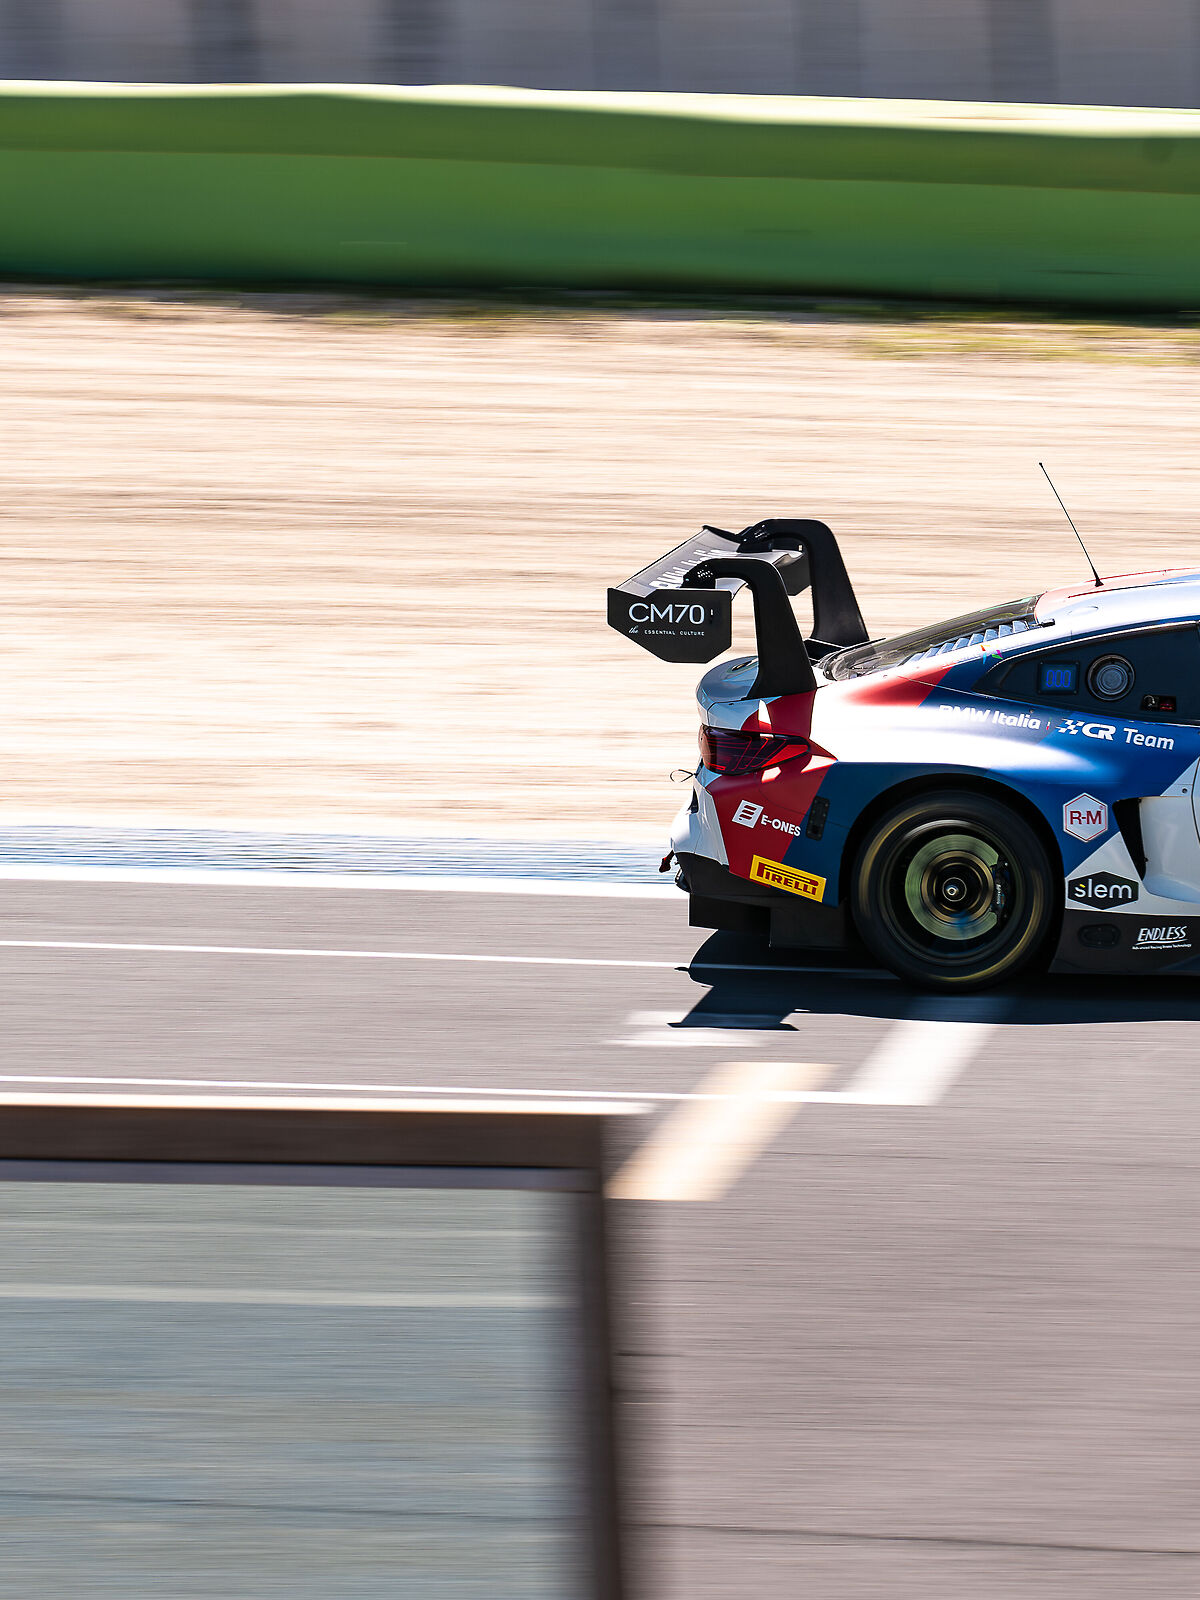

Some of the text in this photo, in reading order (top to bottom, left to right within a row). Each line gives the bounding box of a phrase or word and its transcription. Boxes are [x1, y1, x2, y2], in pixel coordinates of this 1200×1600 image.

[628, 602, 705, 625] CM70
[628, 625, 640, 634] the
[992, 710, 1041, 730] Italia
[1123, 727, 1175, 751] Team
[760, 814, 802, 837] E-ONES
[1069, 810, 1103, 825] R-M
[756, 861, 820, 896] PIRELLI
[1074, 878, 1133, 899] slem
[1137, 926, 1188, 941] ENDLESS
